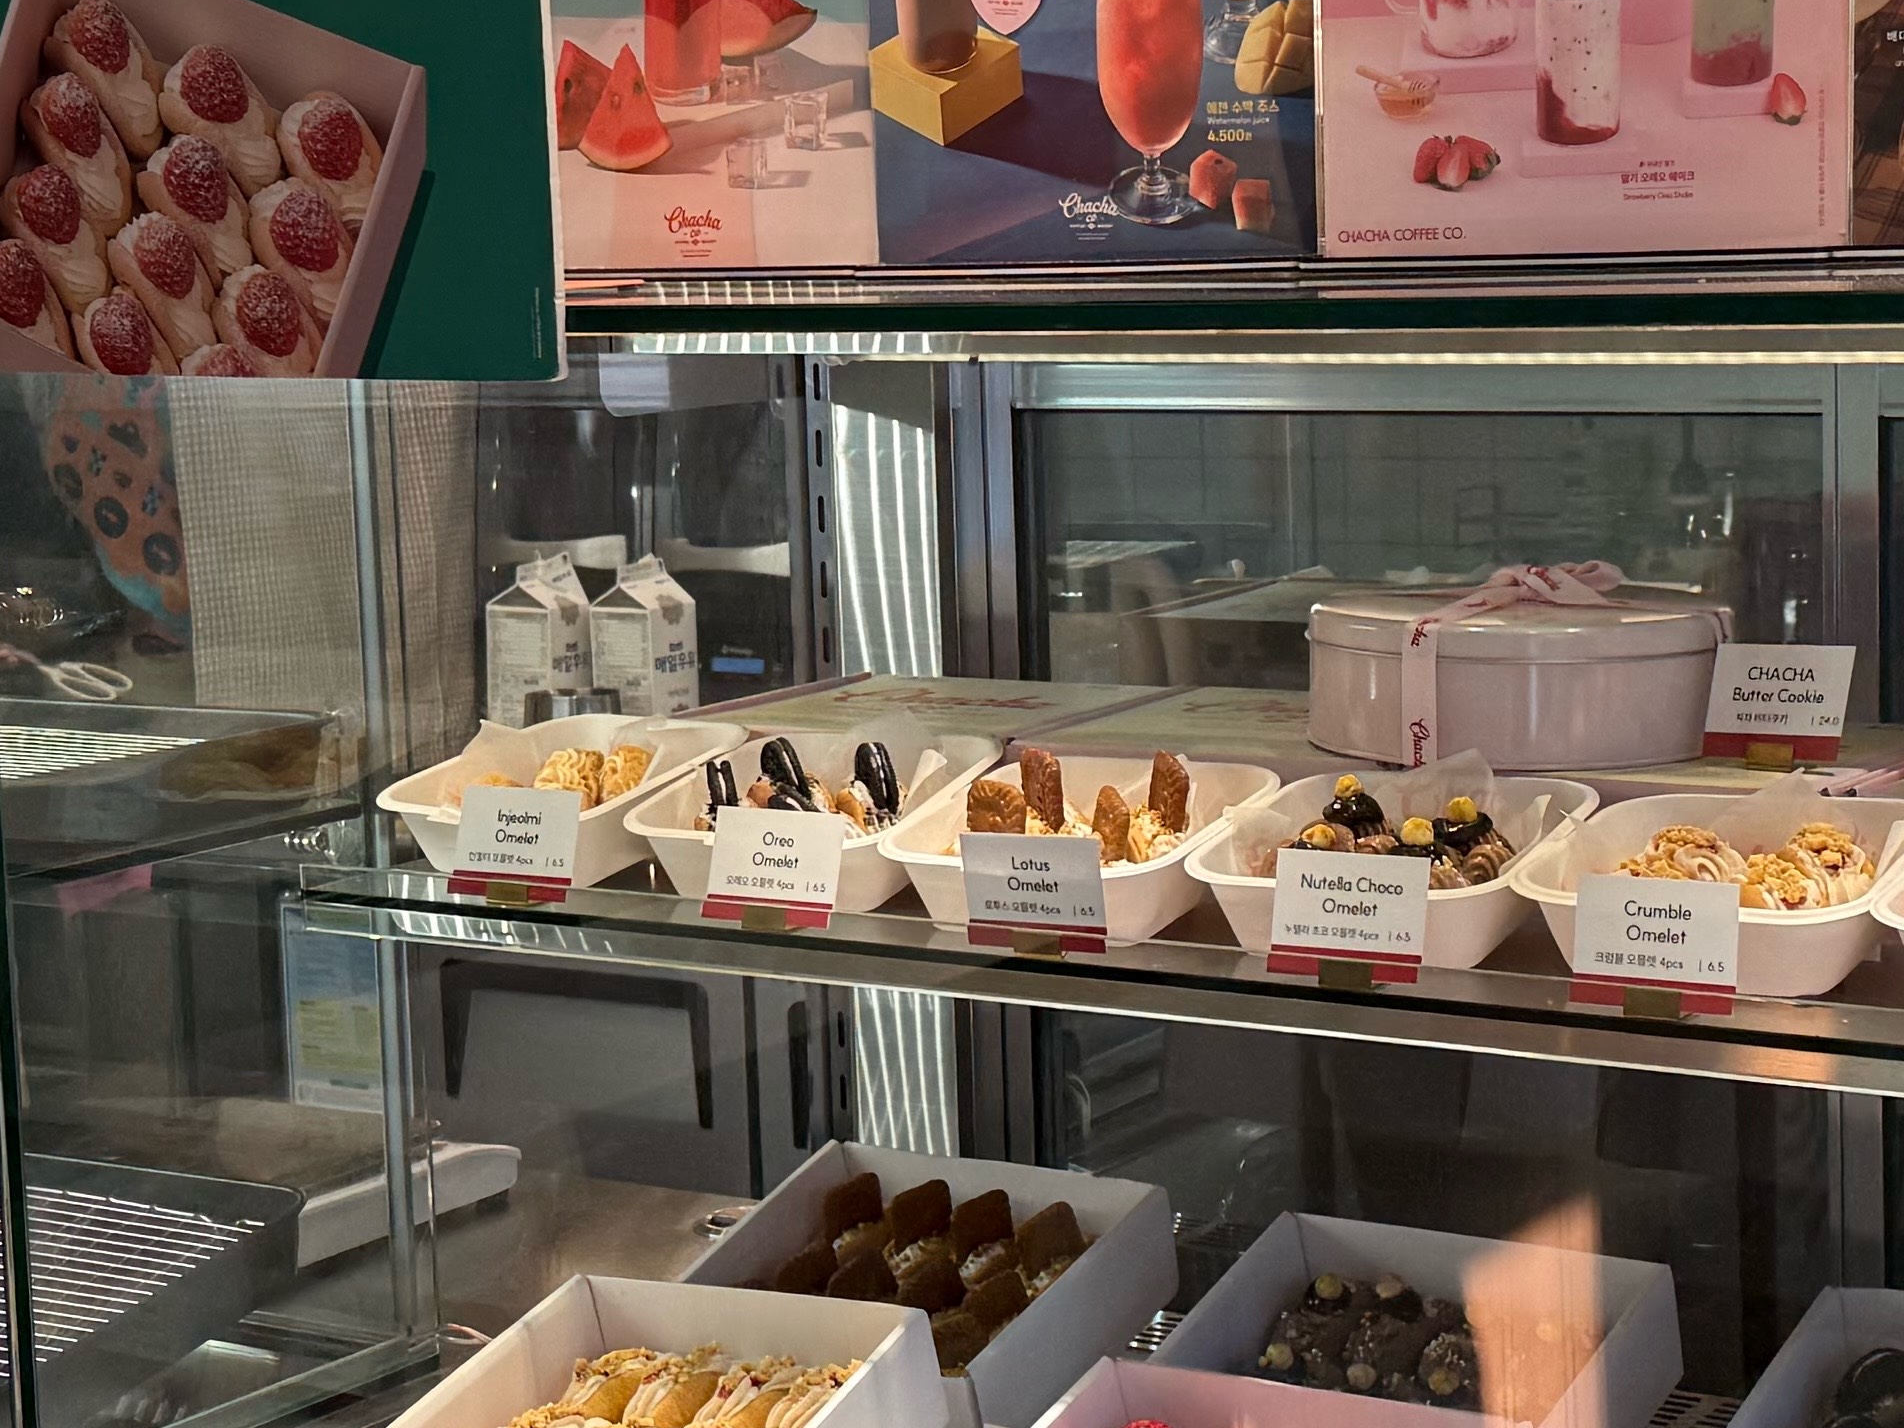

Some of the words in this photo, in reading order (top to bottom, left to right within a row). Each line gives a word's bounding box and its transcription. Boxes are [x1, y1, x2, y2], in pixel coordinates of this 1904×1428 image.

[1059, 192, 1120, 218] Chacha
[664, 206, 722, 234] Chacha
[1339, 230, 1390, 244] CHACHA
[1394, 228, 1440, 241] COFFEE
[1443, 227, 1467, 240] CO.
[1748, 666, 1815, 683] CHACHA
[1732, 688, 1773, 703] Butter
[1777, 689, 1824, 704] Cookie
[495, 829, 539, 847] Omelet
[762, 832, 794, 848] Oreo
[752, 852, 799, 870] Omelet
[1012, 857, 1050, 872] Lotus
[1007, 877, 1059, 893] Omelet
[1357, 878, 1403, 896] Choco
[1322, 899, 1378, 918] Omelet
[1624, 900, 1692, 921] Crumble
[1626, 925, 1686, 944] Omelet
